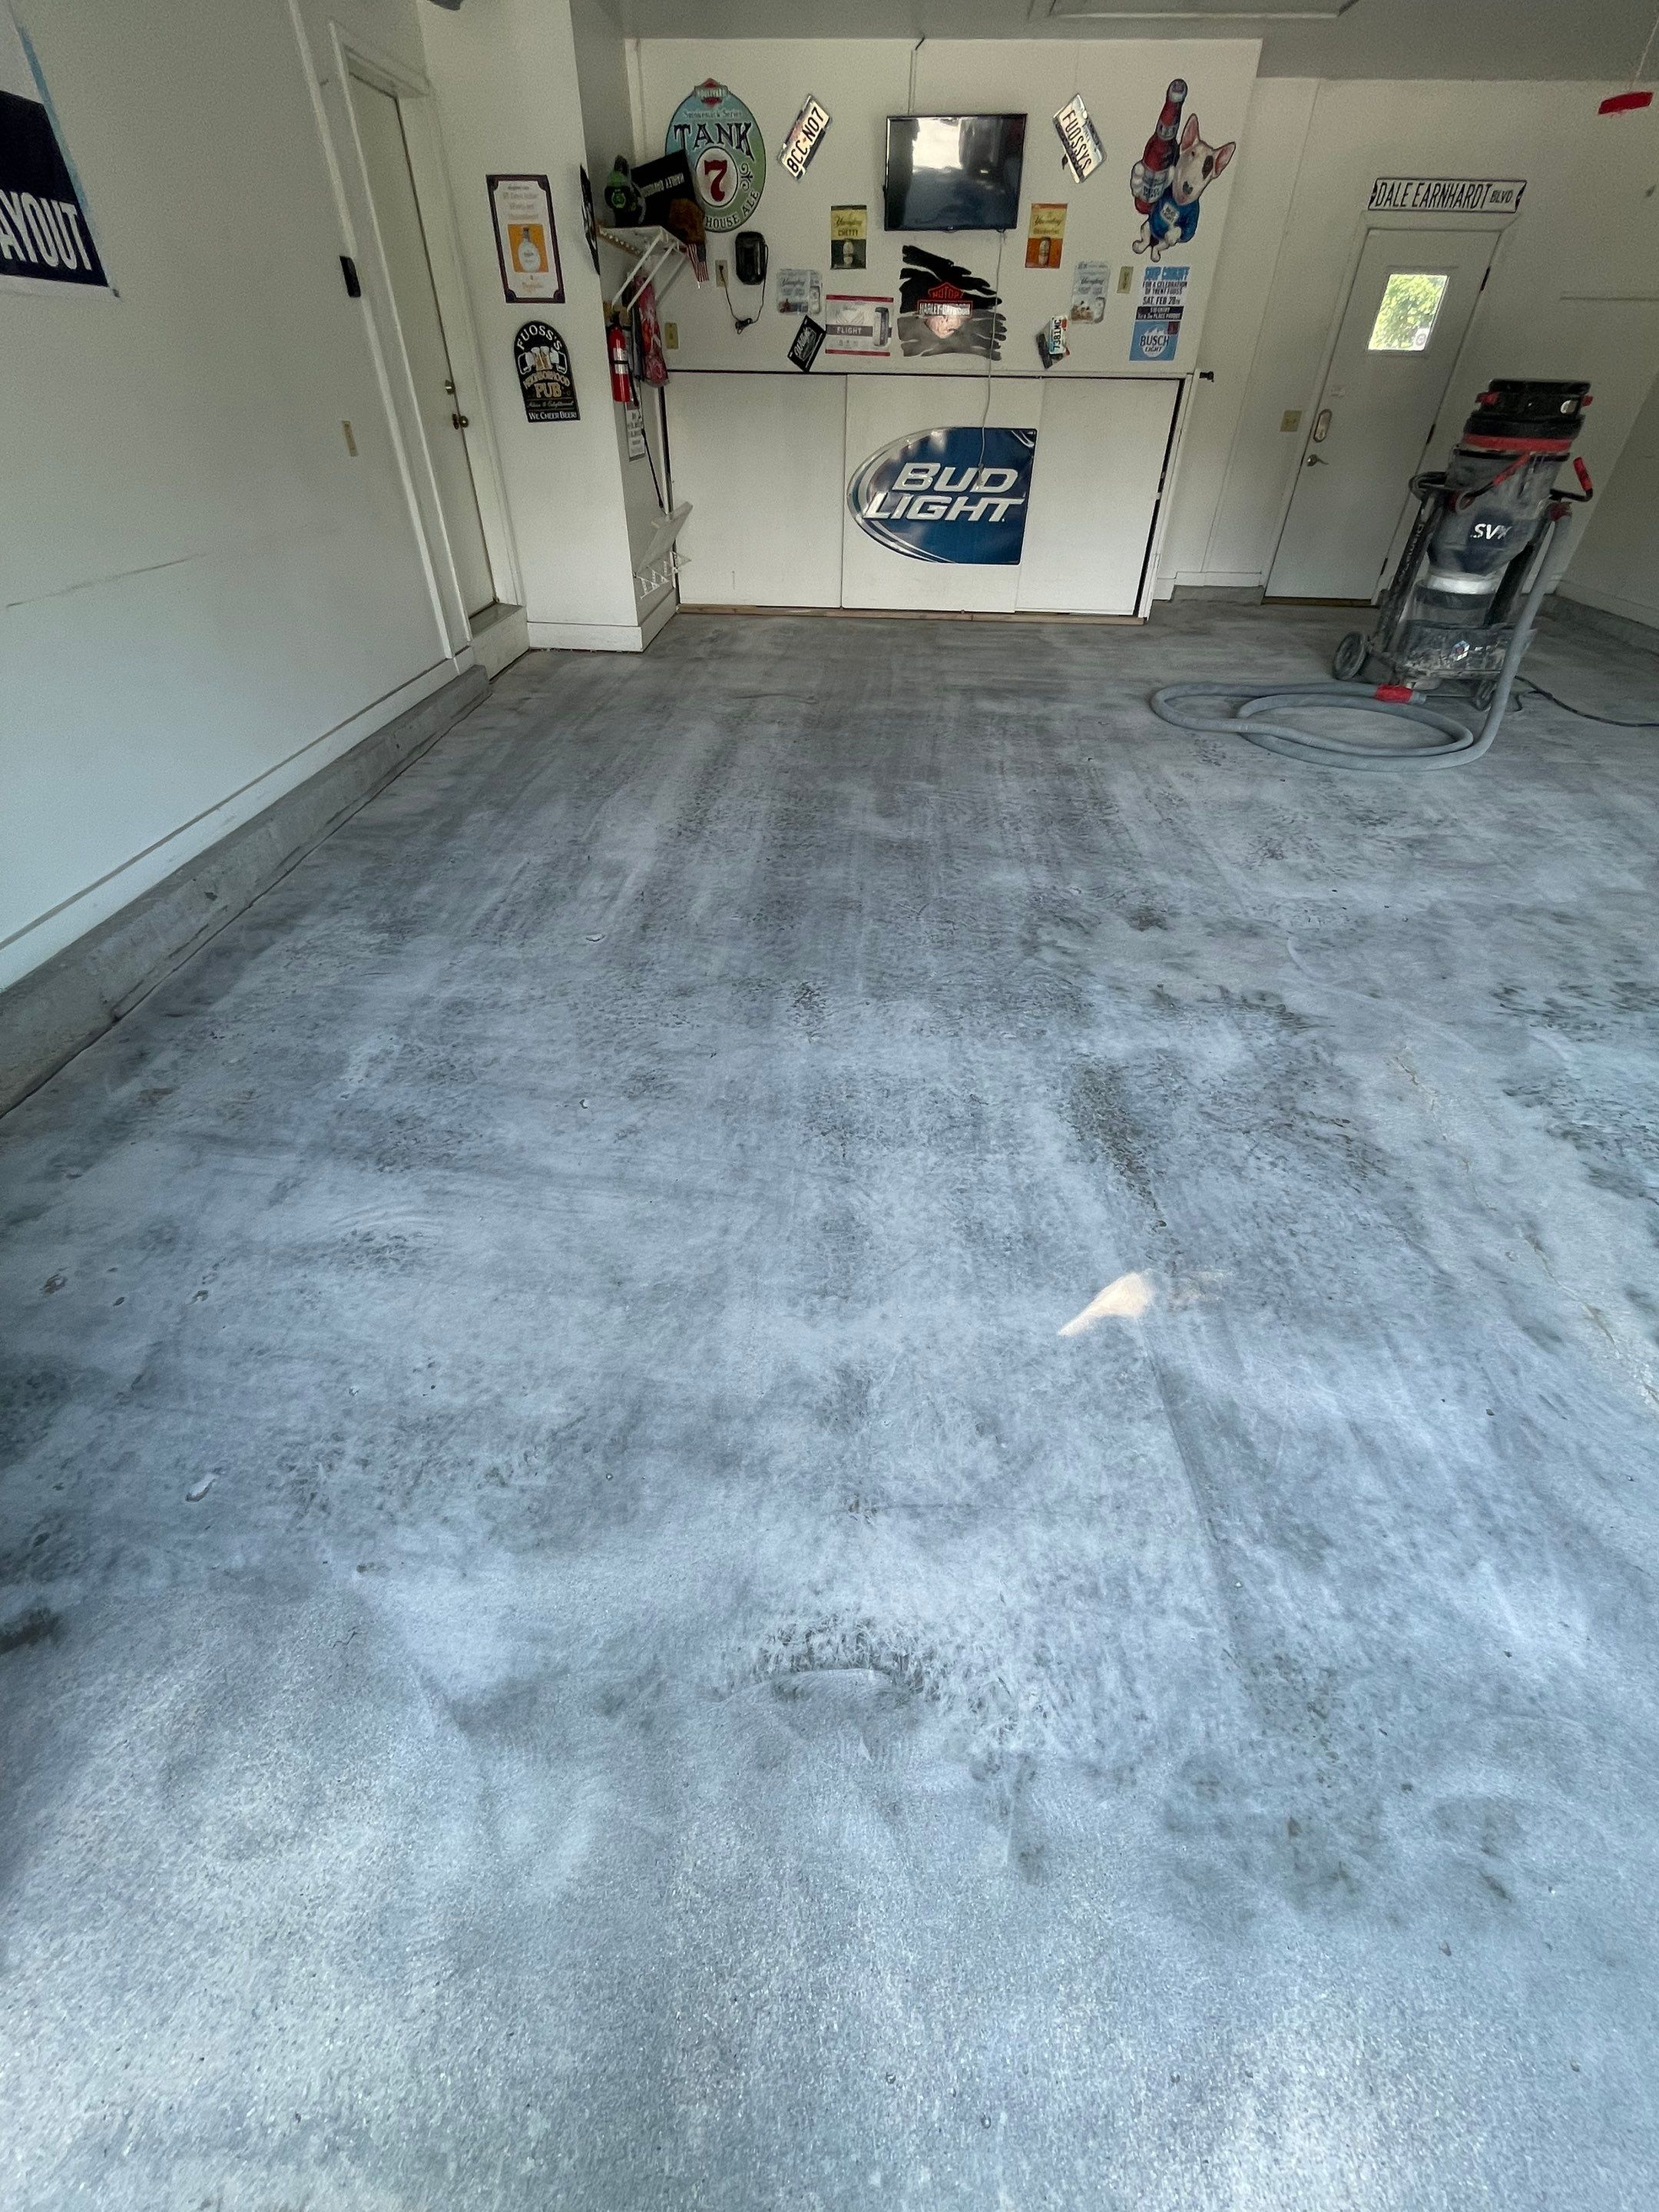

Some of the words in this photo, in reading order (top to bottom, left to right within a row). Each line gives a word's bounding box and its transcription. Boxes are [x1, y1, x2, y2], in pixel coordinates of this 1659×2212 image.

[674, 122, 755, 161] TANK
[1062, 109, 1092, 171] FUOSSYS
[704, 159, 727, 203] 7
[742, 190, 759, 217] ALE
[1375, 182, 1412, 207] DALE
[1412, 182, 1492, 210] EARNHARDT
[1489, 189, 1514, 204] BLVD
[0, 189, 92, 270] AYOUT
[517, 324, 562, 350] FUOSS'S
[836, 326, 862, 335] FLIGHT
[1140, 335, 1170, 347] BUSCH
[534, 382, 562, 399] PUB
[892, 462, 1018, 494] BUD
[863, 492, 1025, 522] LIGHT
